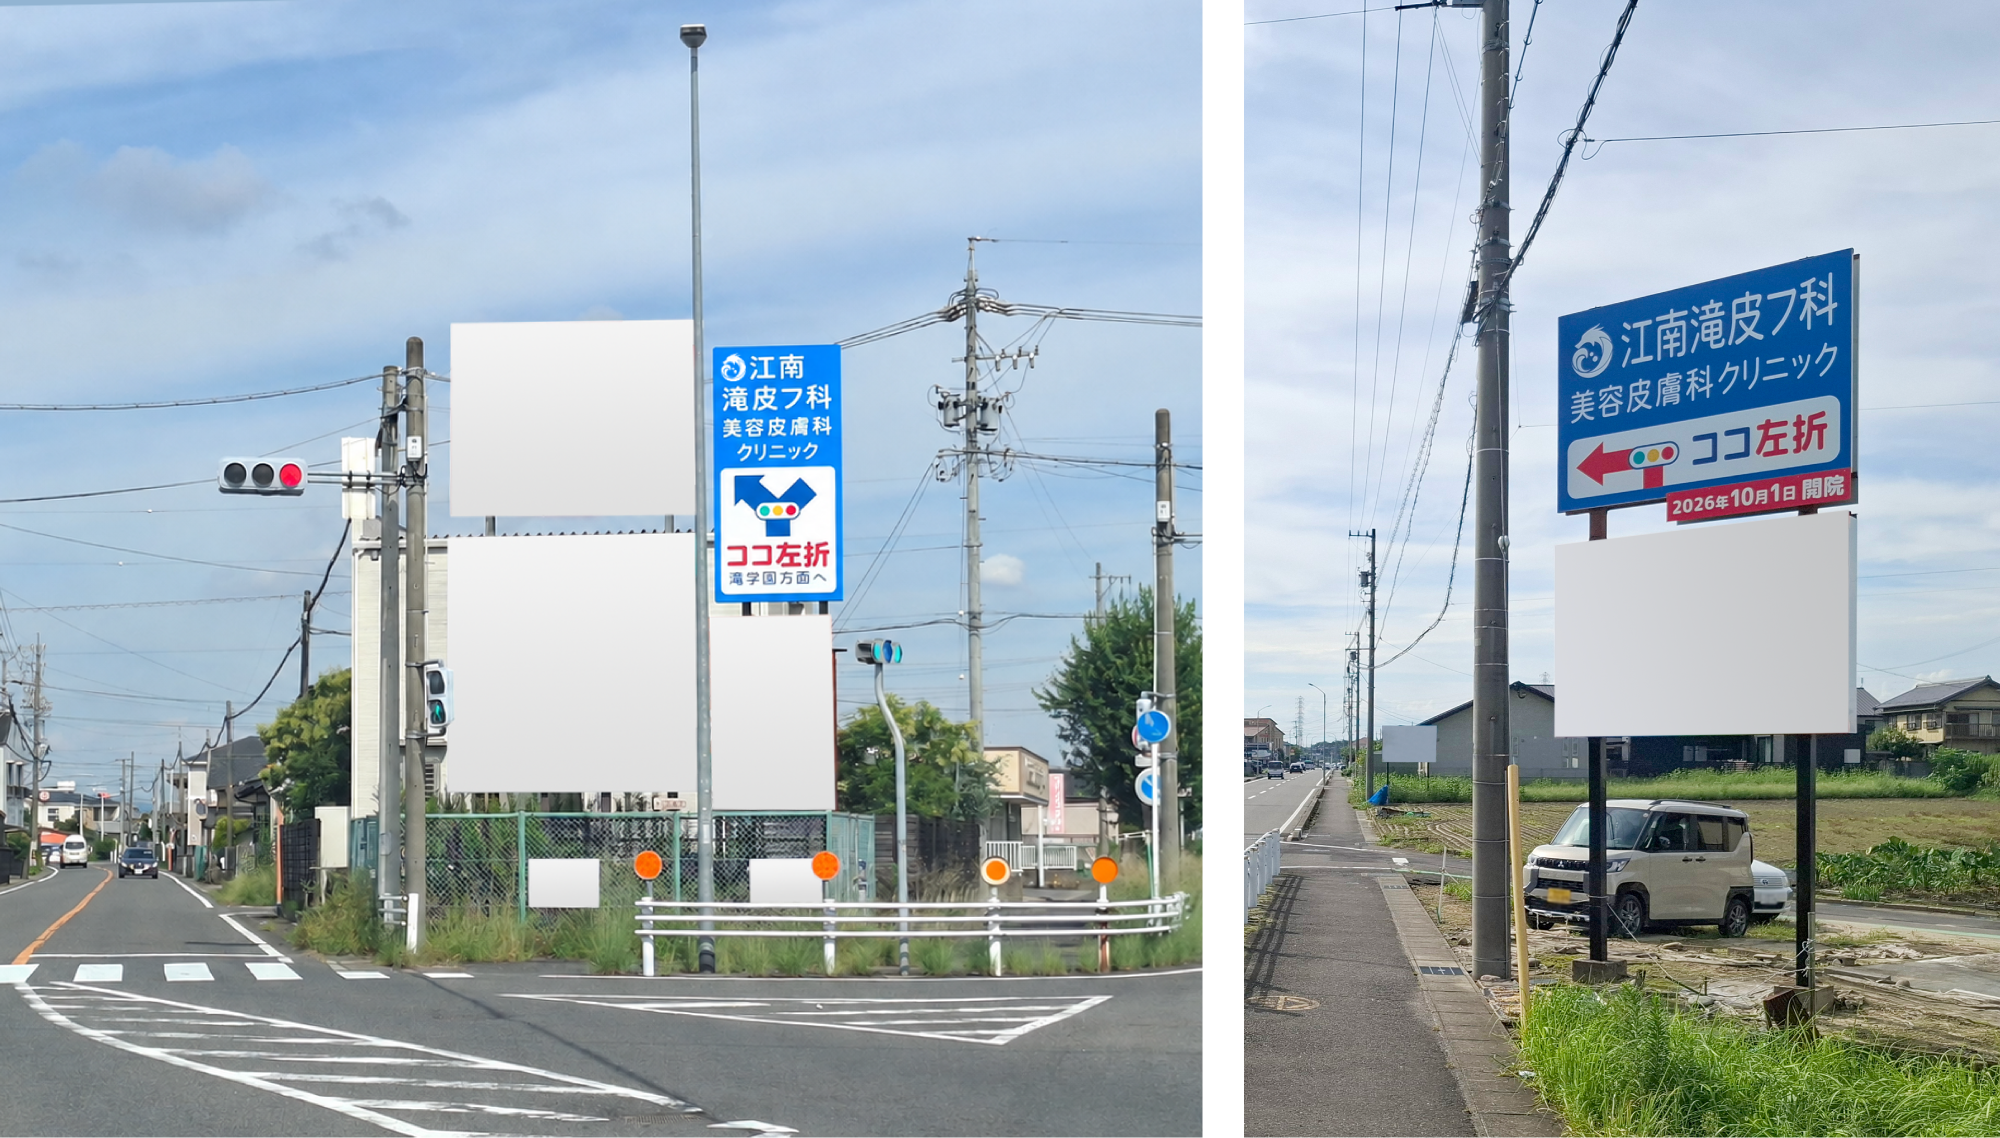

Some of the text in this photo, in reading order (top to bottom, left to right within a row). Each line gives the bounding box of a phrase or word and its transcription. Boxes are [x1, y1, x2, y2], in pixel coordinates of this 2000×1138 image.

[1621, 272, 1838, 369] 江南滝皮フ科
[750, 353, 805, 380] 江南
[722, 383, 832, 412] 滝皮フ科
[723, 415, 832, 438] 美容皮膚科
[1692, 410, 1829, 466] ココ左折
[736, 442, 819, 462] クリニック
[727, 541, 830, 568] ココ左折
